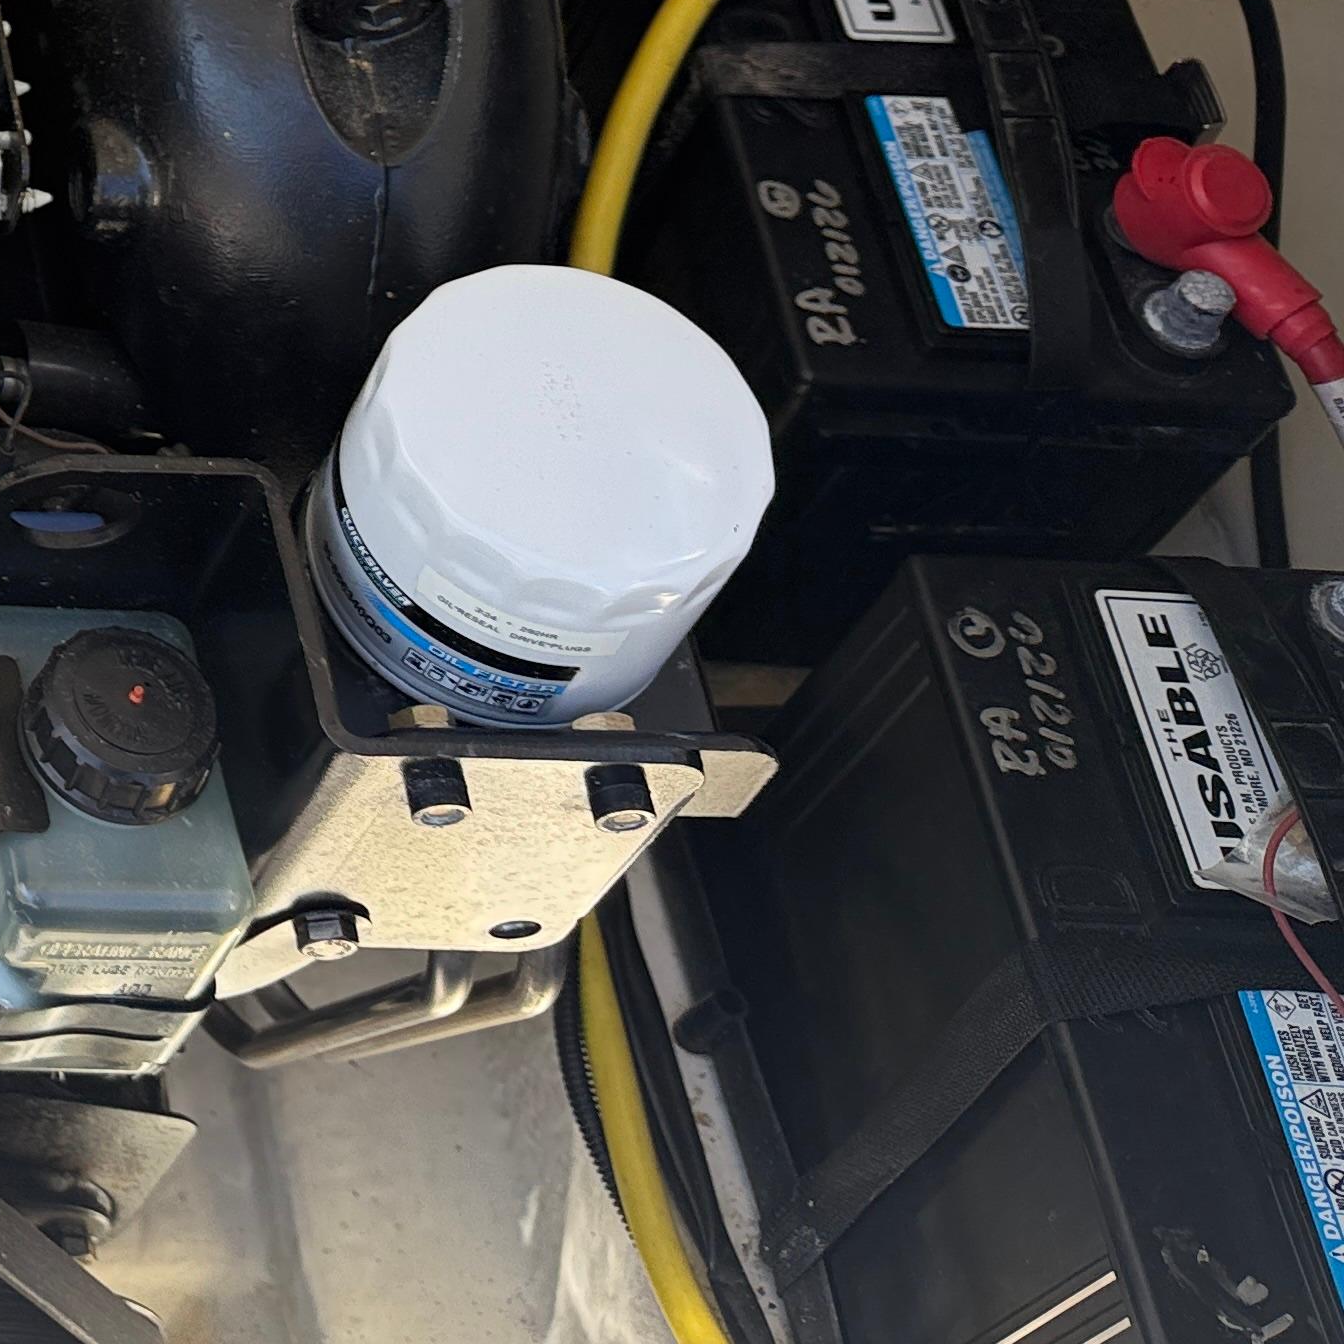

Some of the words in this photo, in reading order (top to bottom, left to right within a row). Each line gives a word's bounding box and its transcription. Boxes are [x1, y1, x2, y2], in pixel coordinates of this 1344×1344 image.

[340, 506, 412, 607] QUICKSILVER
[428, 645, 464, 669] OIL
[472, 668, 558, 694] FILTER
[1156, 708, 1185, 762] THE
[1229, 713, 1247, 747] 21226
[1215, 724, 1244, 787] PRODUCTS
[1241, 747, 1254, 766] MD
[1294, 992, 1311, 1009] GET
[1277, 1030, 1296, 1052] EYES
[1316, 1019, 1334, 1041] HELP
[1285, 1053, 1306, 1081] FLUSH
[1287, 1023, 1318, 1082] IMMEDIATELY
[1312, 1060, 1331, 1083] WITH
[1265, 1054, 1342, 1241] DANGER/POISON
[1307, 1116, 1329, 1160] SULFURIC
